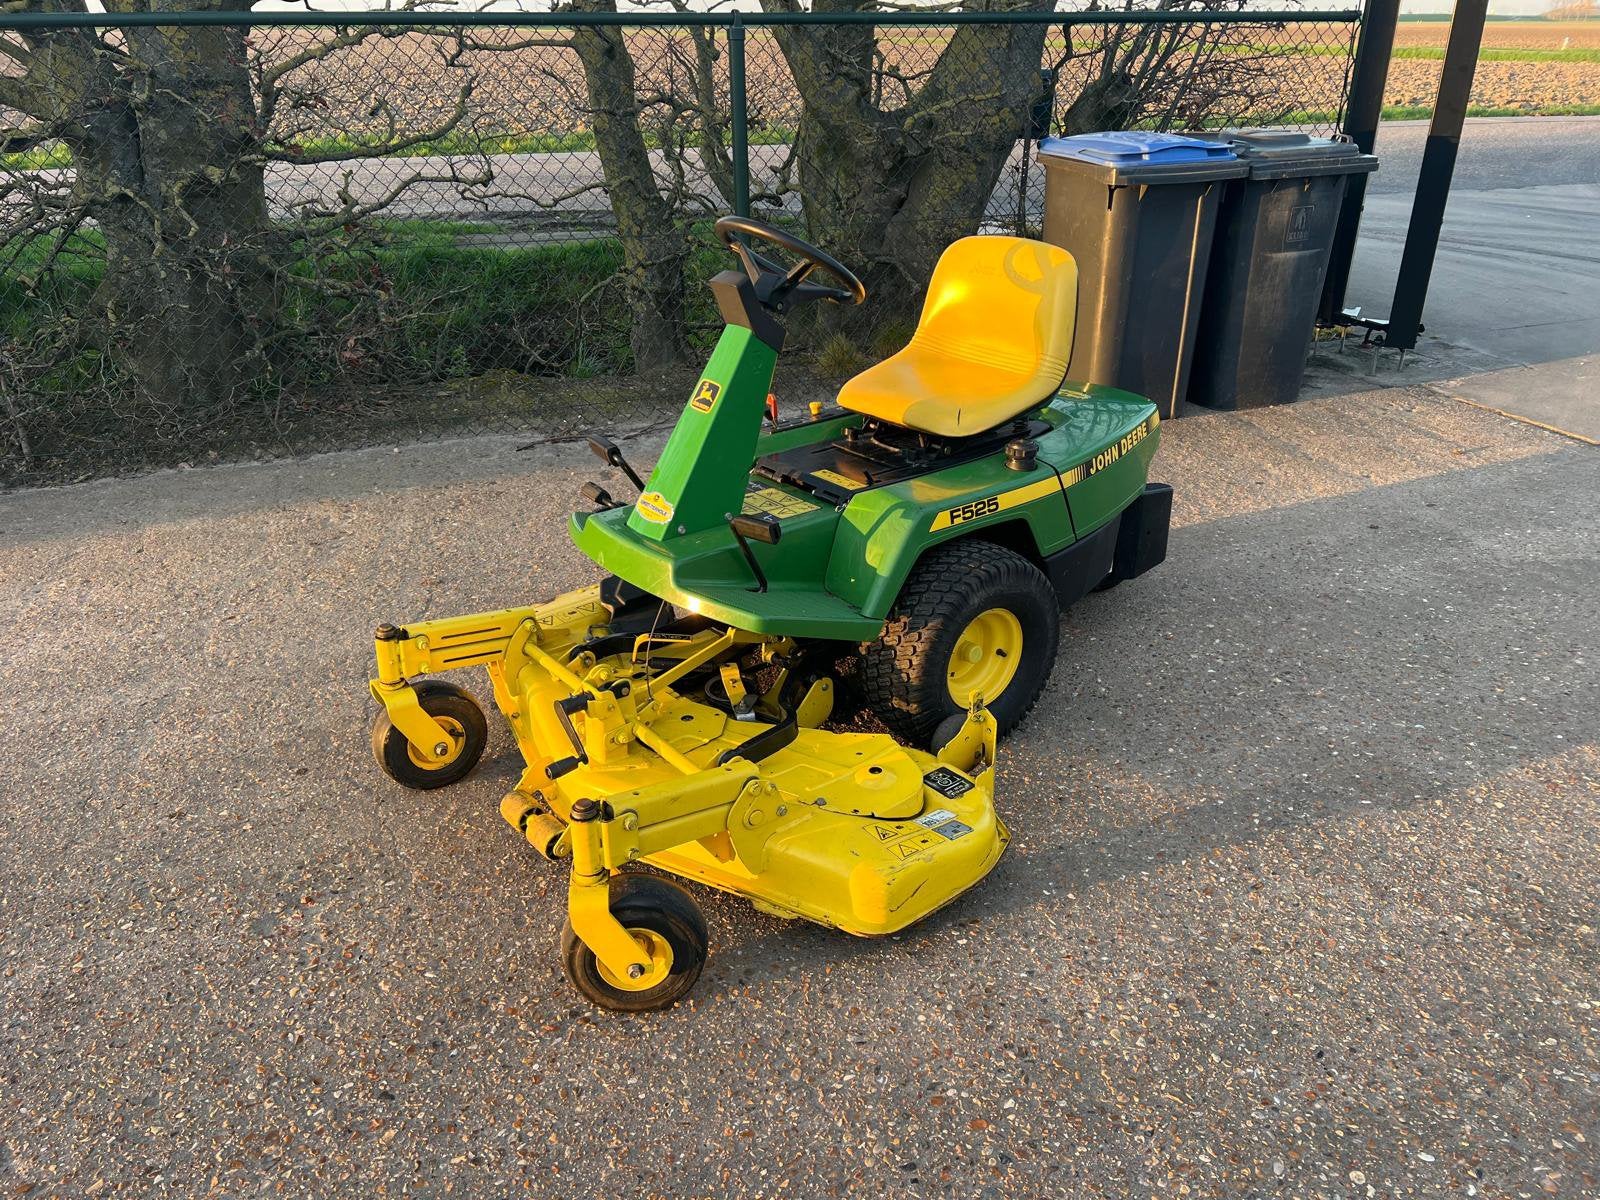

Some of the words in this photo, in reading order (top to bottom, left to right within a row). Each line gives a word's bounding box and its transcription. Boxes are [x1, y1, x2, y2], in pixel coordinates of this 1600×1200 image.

[1090, 444, 1119, 475] JOHN
[1120, 422, 1148, 456] DEERE
[950, 496, 1000, 525] F525
